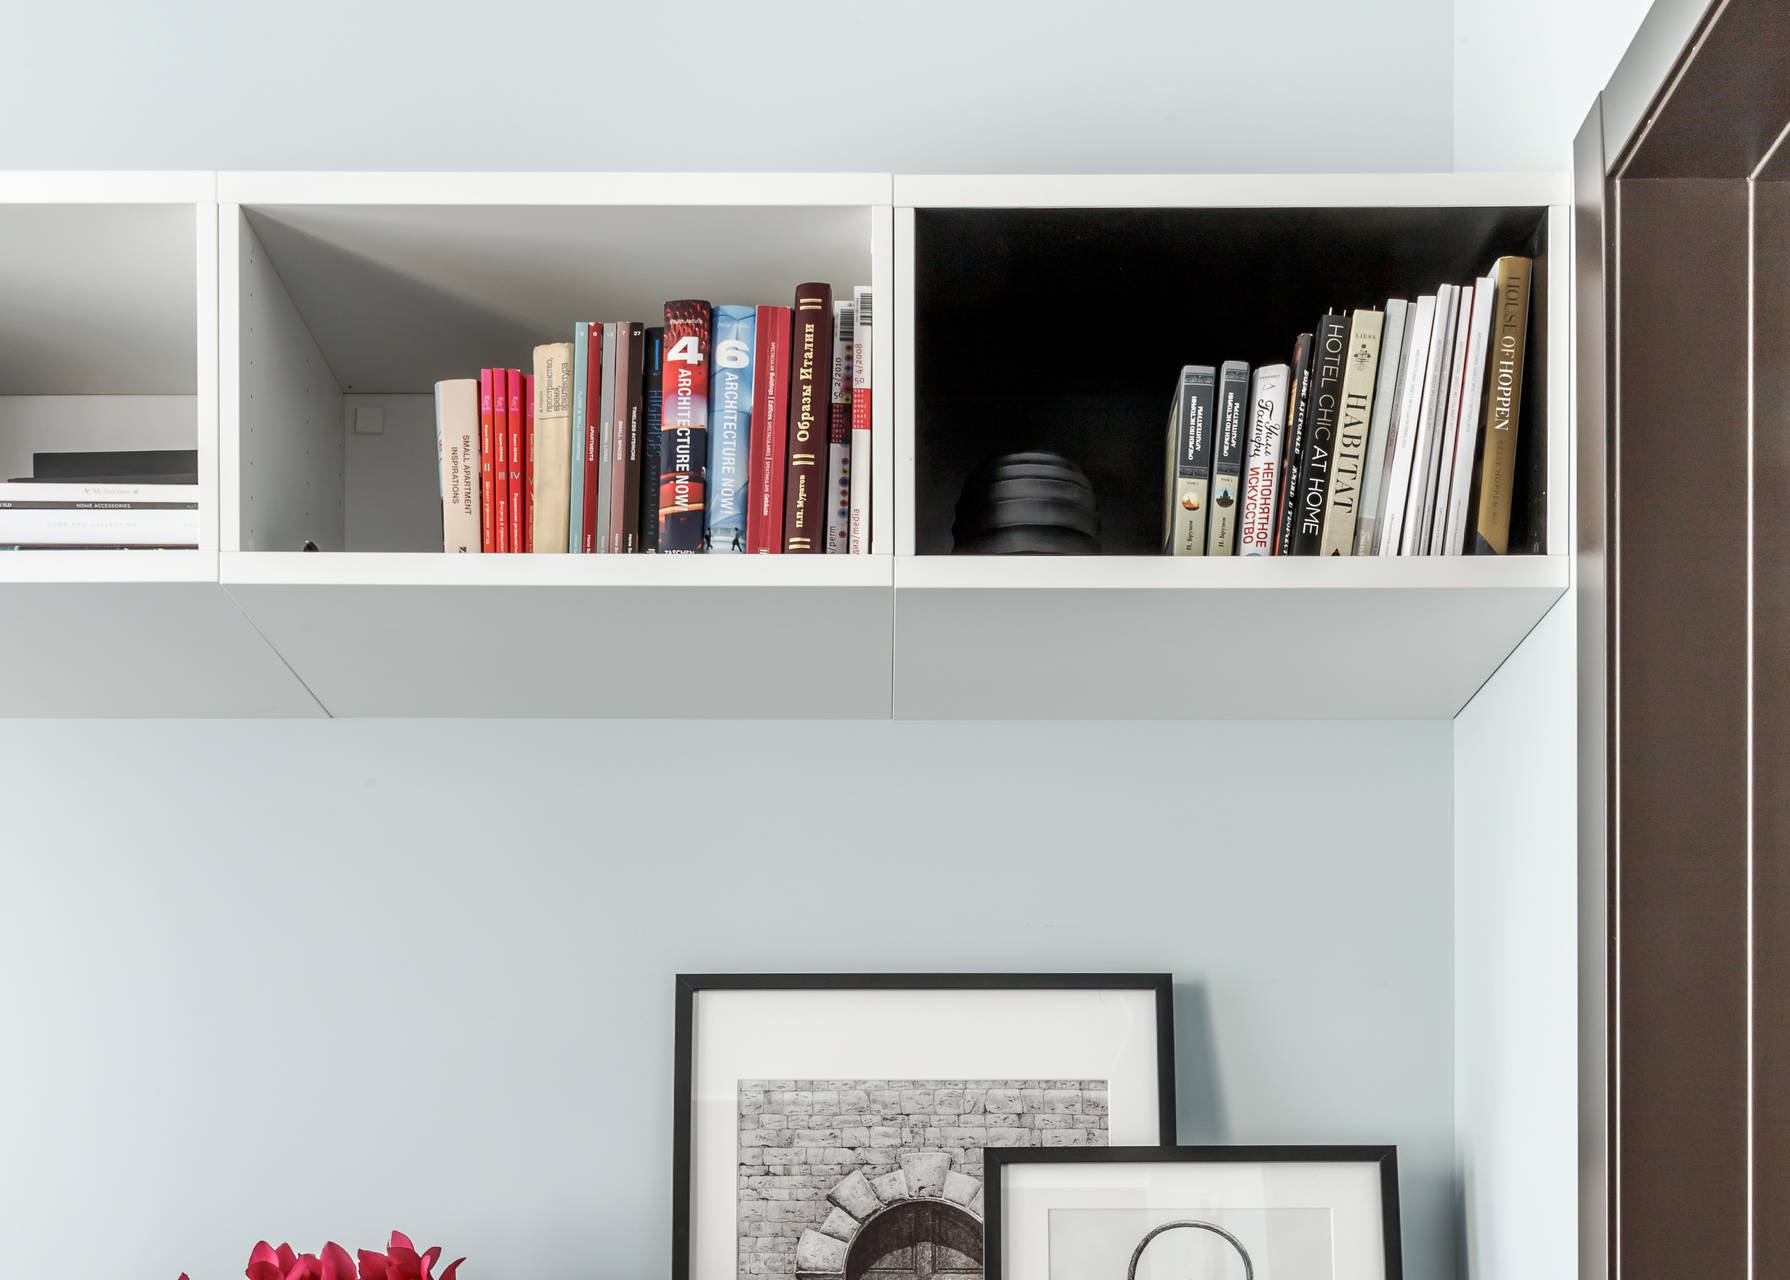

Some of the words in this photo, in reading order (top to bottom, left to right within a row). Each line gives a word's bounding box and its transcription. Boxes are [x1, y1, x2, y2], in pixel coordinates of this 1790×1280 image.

[1502, 276, 1521, 334] HOUSE
[667, 336, 704, 365] 4
[715, 340, 750, 368] 6
[799, 322, 815, 381] Италии
[854, 343, 864, 375] 4/2008
[1321, 324, 1344, 388] HOTEL
[1500, 335, 1516, 358] OF
[767, 372, 775, 396] Buildings
[833, 357, 842, 387] 2/2010
[796, 384, 815, 442] Образы
[1189, 395, 1198, 426] ИСТОРИИ
[1225, 391, 1234, 422] ИСТОРИИ
[1314, 393, 1335, 441] CHIC
[1494, 360, 1514, 431] HOPPEN
[676, 368, 692, 472] ARCHITECTURE
[721, 372, 739, 474] ARCHITECTURE
[1195, 405, 1204, 452] АРХИТЕКТУРЫ
[1231, 402, 1240, 448] АРХИТЕКТУРЫ
[1248, 399, 1273, 458] Гомперц
[1264, 421, 1281, 456] Уилл
[462, 434, 470, 463] SMALL
[1187, 435, 1195, 461] ОЧЕРКИ
[1222, 432, 1230, 457] ОЧЕРКИ
[1311, 444, 1328, 472] AT
[1333, 393, 1368, 515] HABITAT
[450, 446, 460, 504] INSPIRATIONS
[463, 466, 472, 515] APARTMENT
[674, 475, 689, 512] NOW!
[719, 477, 734, 515] NOW!
[796, 474, 807, 508] Муратов
[1243, 467, 1261, 545] ИСКУССТВО
[1256, 462, 1275, 548] НЕПОНЯТНОЕ
[1302, 477, 1323, 536] HOME
[1282, 510, 1293, 555] ТВОРЧЕСТ
